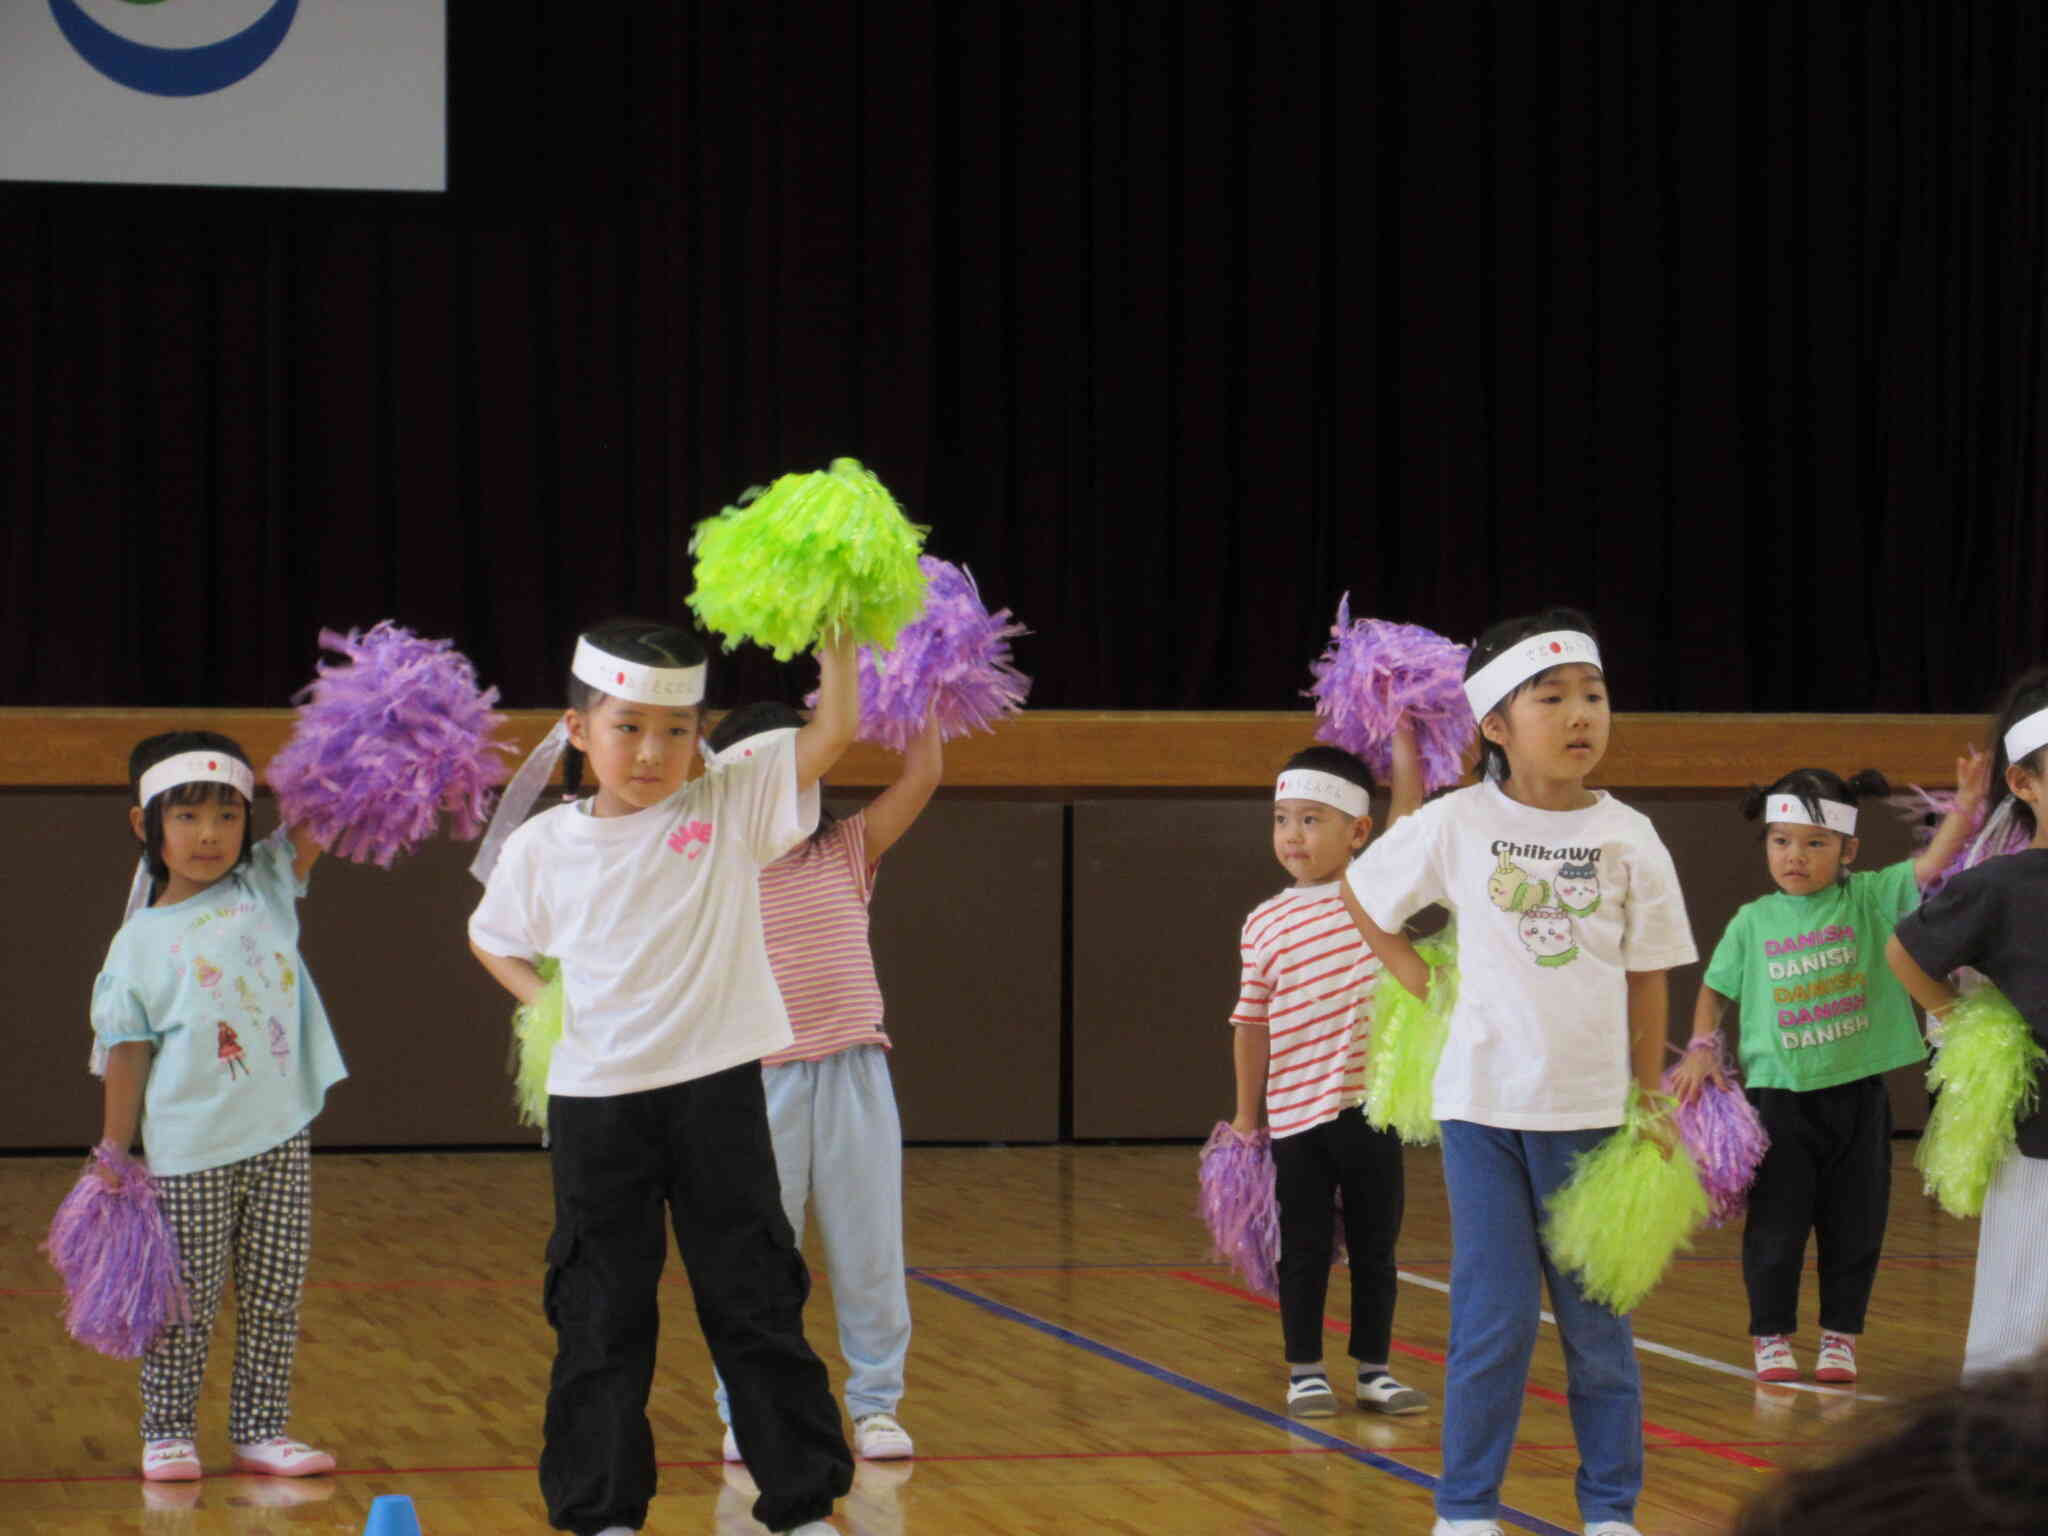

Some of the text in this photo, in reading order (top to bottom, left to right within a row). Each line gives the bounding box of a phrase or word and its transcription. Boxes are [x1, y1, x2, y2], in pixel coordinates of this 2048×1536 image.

[1490, 839, 1602, 862] Chiikawa
[1764, 925, 1855, 957] DANISH
[1768, 947, 1857, 980] DANISH
[1777, 995, 1867, 1027] DANISH
[1781, 1016, 1870, 1049] DANISH
